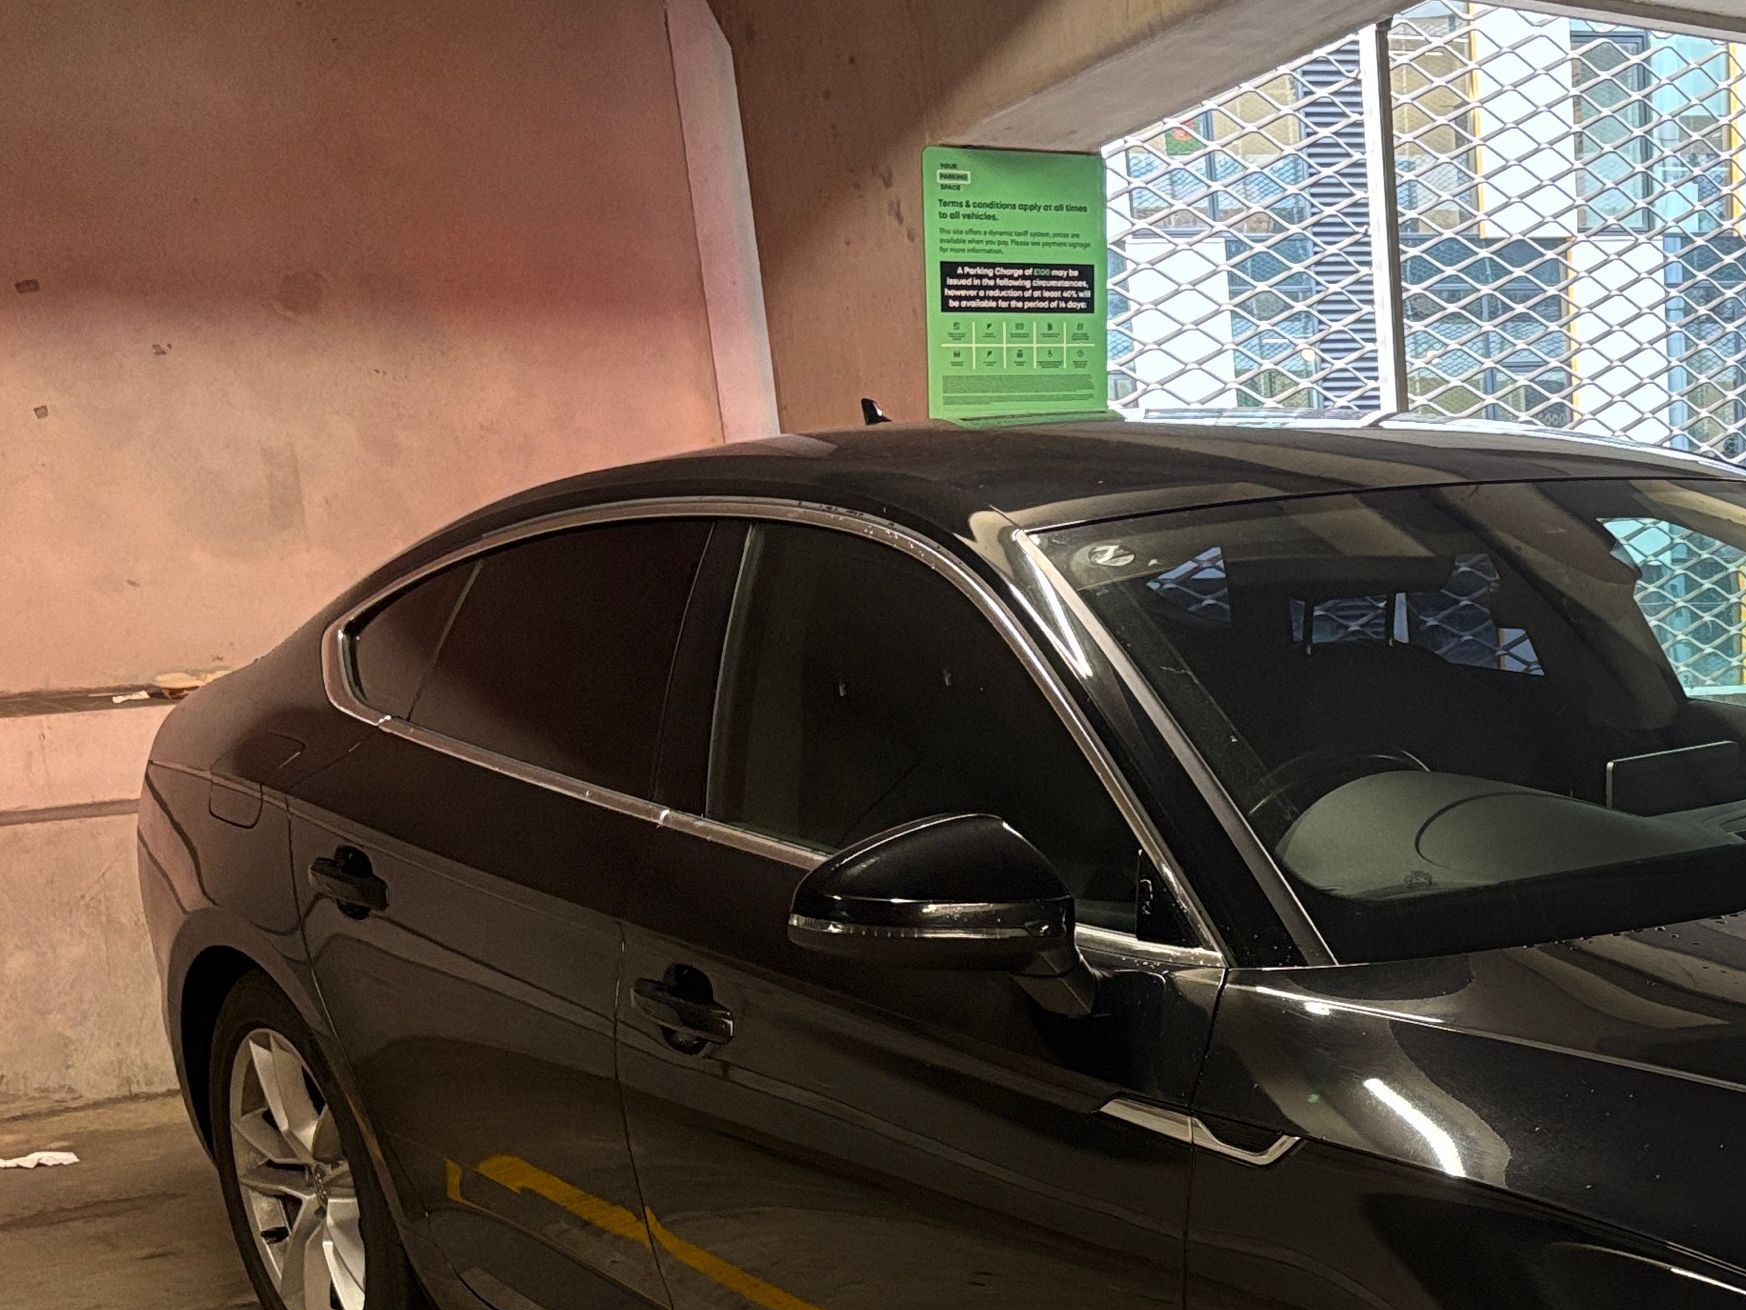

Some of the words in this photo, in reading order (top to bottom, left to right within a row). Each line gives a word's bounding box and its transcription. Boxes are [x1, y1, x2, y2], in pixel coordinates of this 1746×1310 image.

[938, 199, 963, 208] Terms
[972, 201, 1016, 210] conditions
[1018, 203, 1042, 212] apply
[1053, 203, 1064, 211] all
[1065, 204, 1087, 213] times
[938, 211, 948, 219] to
[949, 211, 960, 219] all
[962, 212, 999, 221] vehicles.
[988, 229, 1013, 237] dynamic
[964, 267, 993, 276] Parking
[995, 267, 1023, 277] Charge
[1051, 270, 1068, 278] may
[981, 278, 995, 286] the
[996, 278, 1031, 288] following
[1032, 279, 1089, 288] circumstances,
[944, 288, 978, 296] however
[986, 289, 1022, 297] reduction
[1023, 289, 1032, 297] of
[1078, 290, 1091, 298] will
[949, 299, 959, 307] be
[961, 299, 996, 308] available
[998, 300, 1009, 308] for
[1010, 300, 1023, 308] the
[1024, 300, 1049, 309] period
[1050, 300, 1057, 308] of
